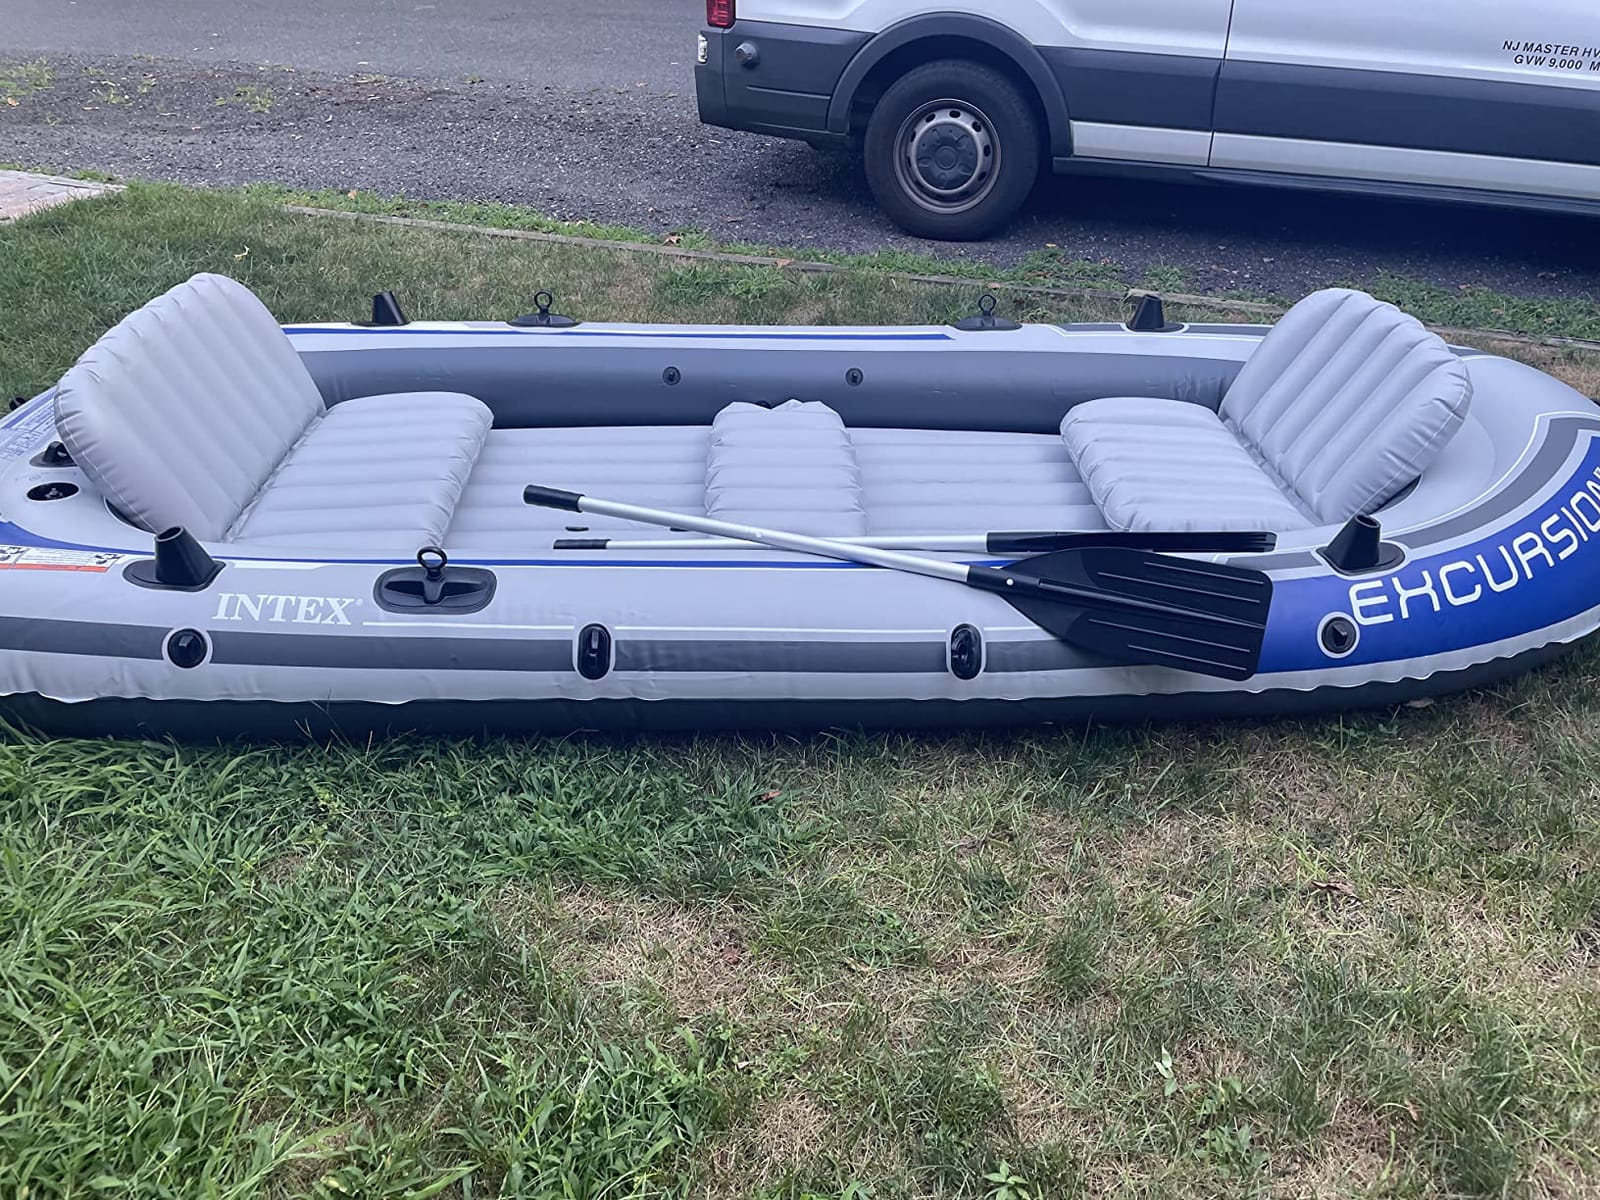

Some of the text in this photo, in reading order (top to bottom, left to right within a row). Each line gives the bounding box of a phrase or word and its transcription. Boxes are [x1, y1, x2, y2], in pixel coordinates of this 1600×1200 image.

[1503, 40, 1521, 51] NJ
[1522, 42, 1580, 57] MASTER
[1514, 54, 1546, 66] GVW
[1349, 466, 1600, 626] EXCURSIO
[211, 593, 354, 625] INTEX
